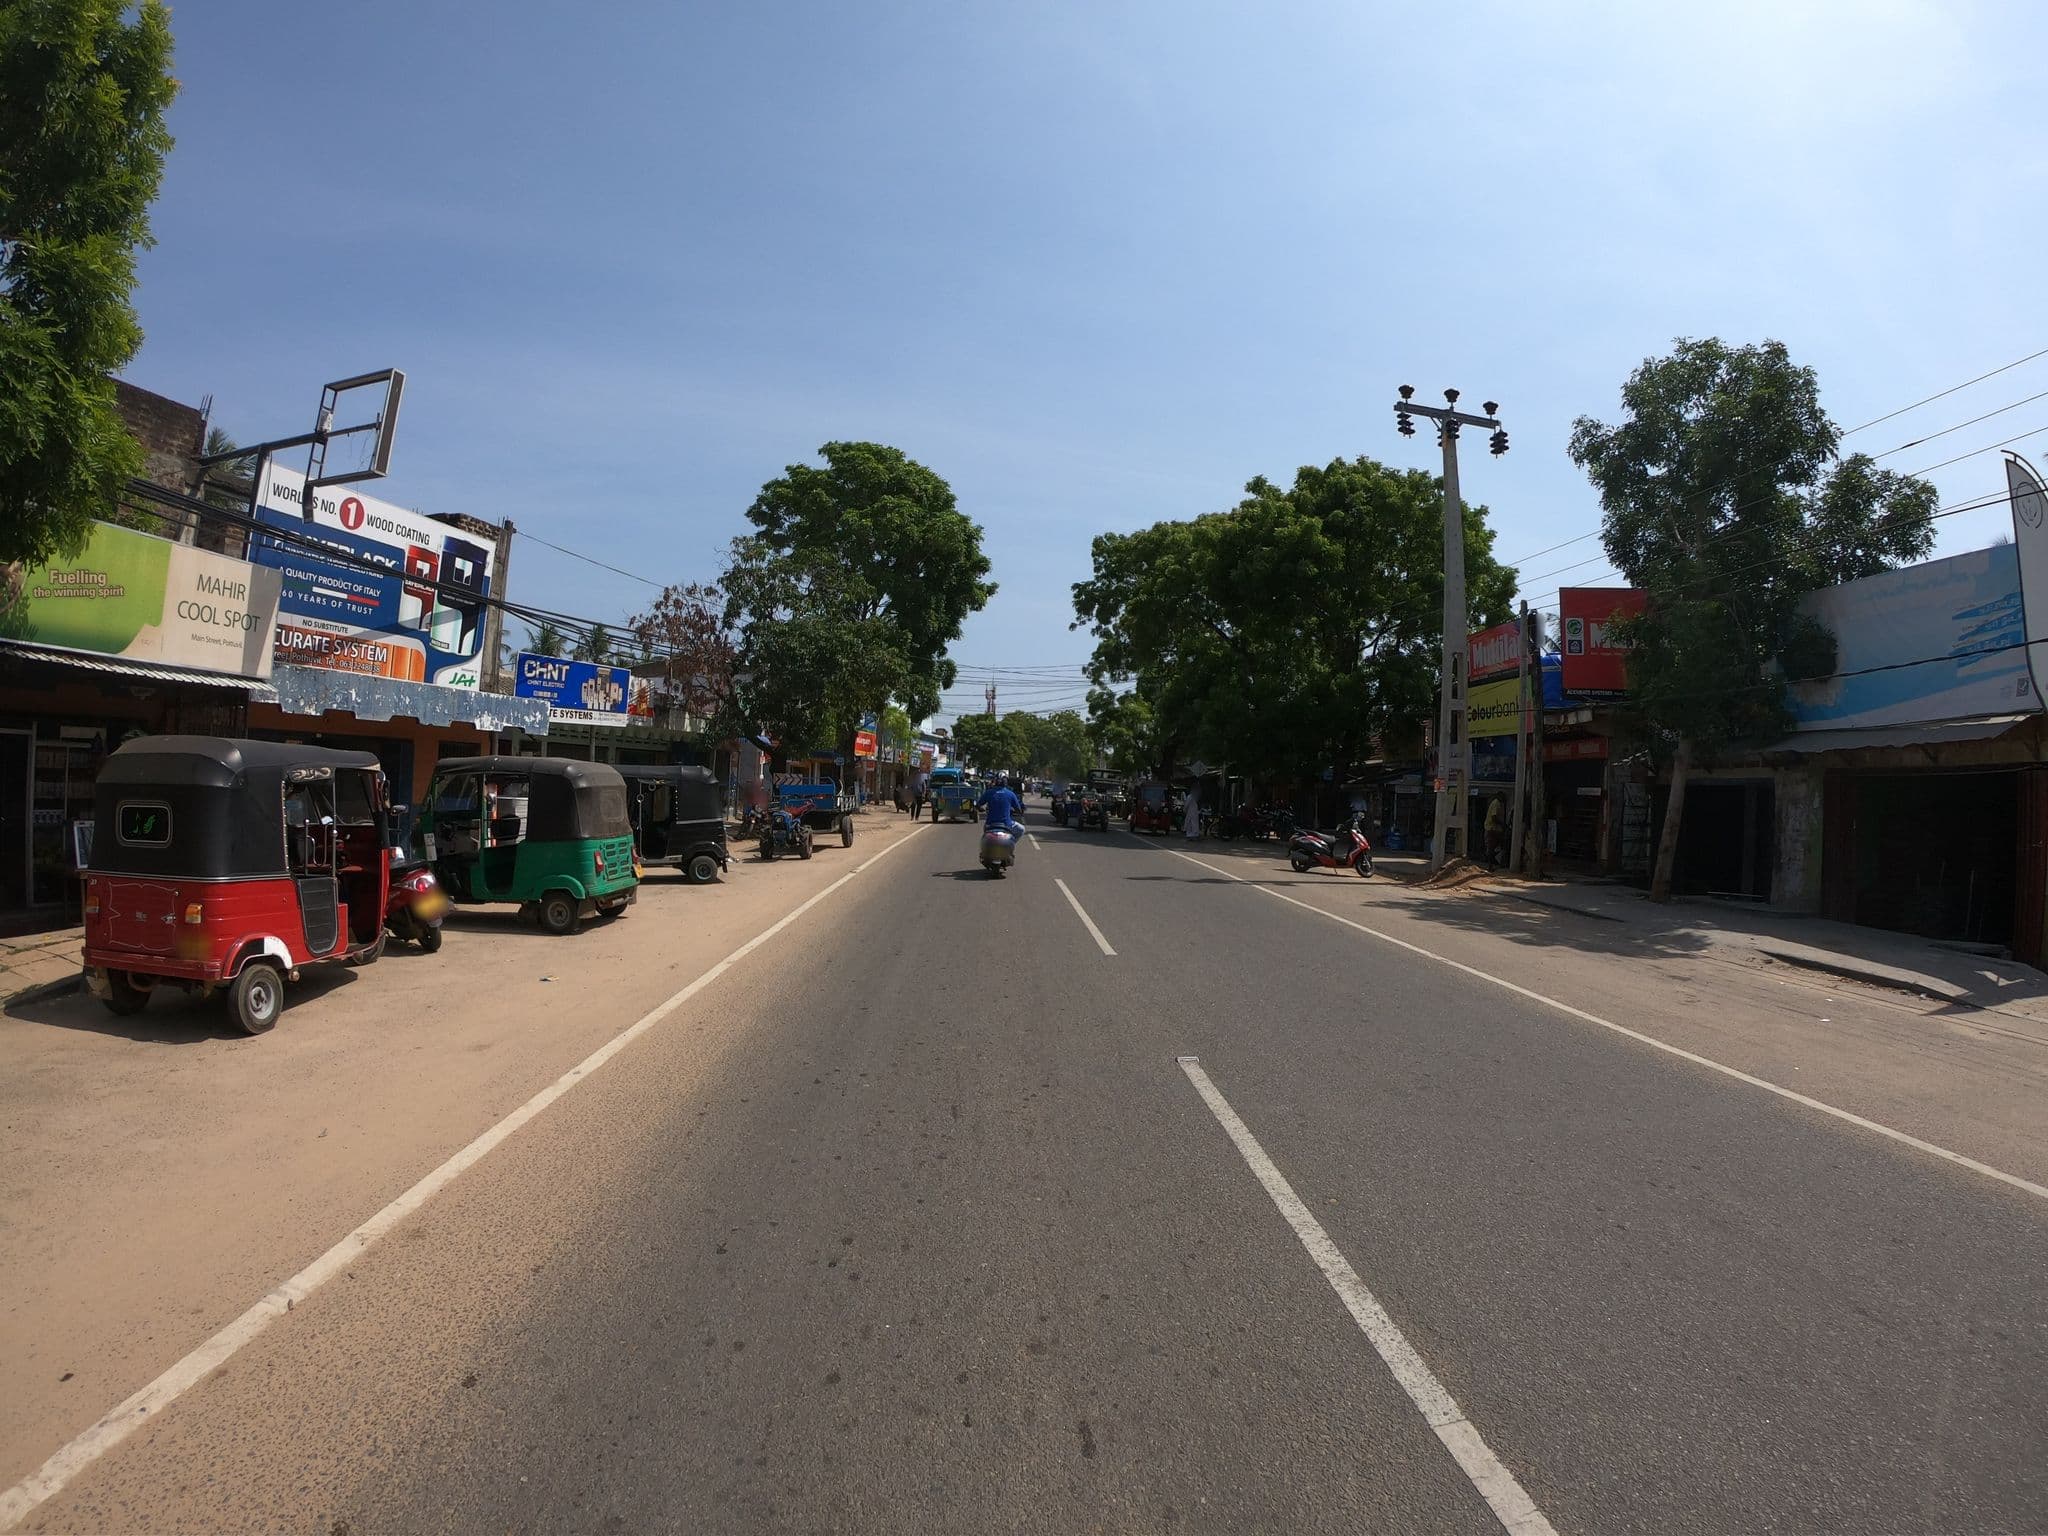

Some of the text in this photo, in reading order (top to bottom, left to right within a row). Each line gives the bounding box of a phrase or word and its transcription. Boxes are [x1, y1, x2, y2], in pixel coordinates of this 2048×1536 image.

[273, 482, 318, 510] WORLS
[321, 499, 337, 516] NO.
[367, 513, 394, 533] WOOD
[395, 523, 431, 546] COATING
[49, 569, 108, 587] Fuelling
[196, 573, 246, 601] MAHIR
[285, 567, 317, 582] QUALITY
[318, 574, 353, 591] PRODUCT
[352, 584, 363, 594] OF
[363, 586, 381, 597] ITALY
[33, 585, 125, 599] the winning spirit
[281, 589, 373, 615] 60 YEARS OF TRUST
[177, 600, 261, 632] COOL SPOT
[302, 619, 348, 634] NO SUBSTITUTE
[333, 639, 388, 662] SYSTEM
[1472, 633, 1520, 672] Multila
[542, 681, 565, 689] ELECTRIC
[560, 709, 594, 720] SYSTEMS
